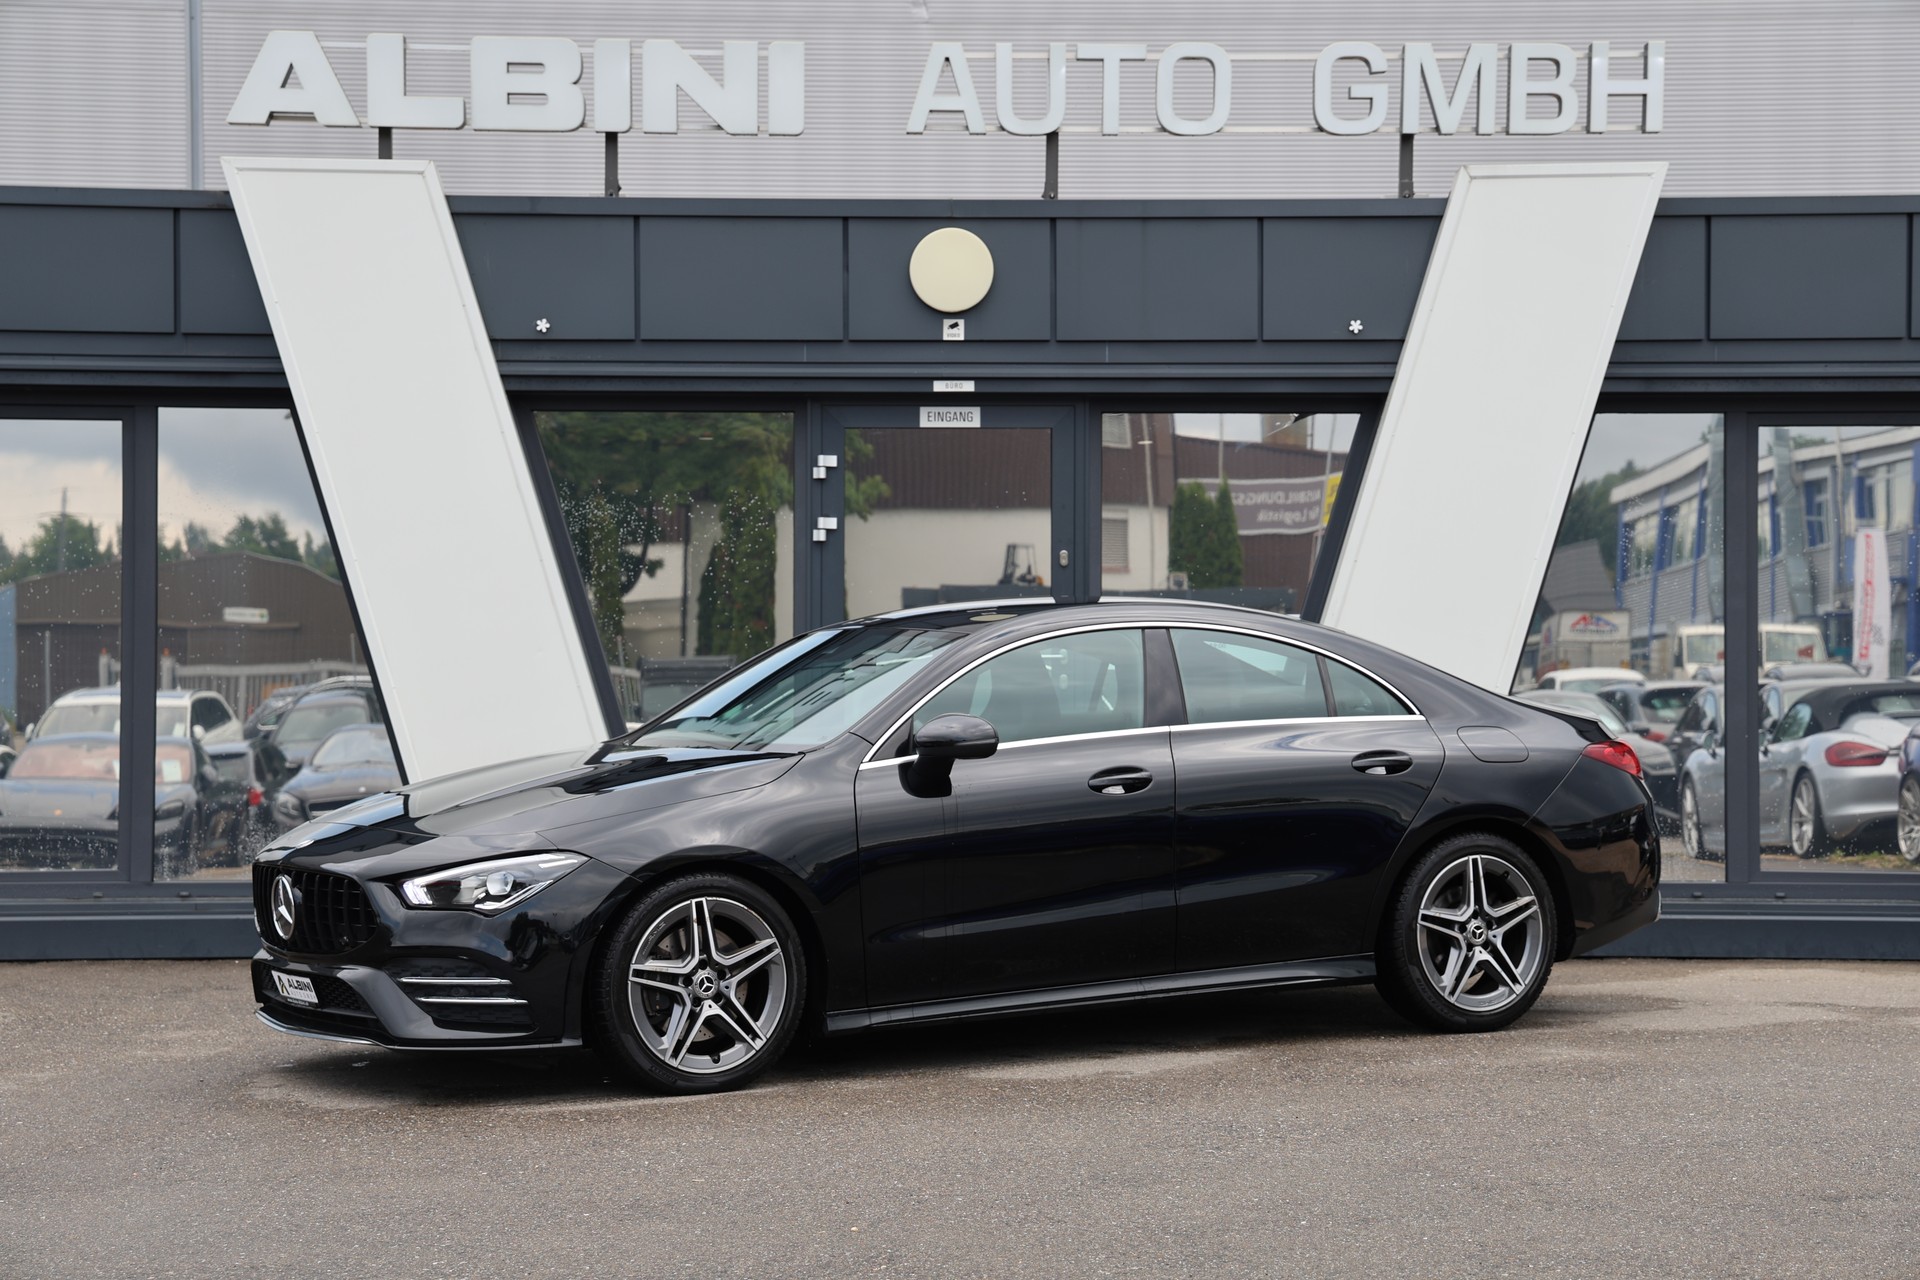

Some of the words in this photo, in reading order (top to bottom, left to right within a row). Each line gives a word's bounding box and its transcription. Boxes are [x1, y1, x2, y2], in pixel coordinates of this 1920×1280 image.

[227, 30, 805, 136] ALBINI
[906, 41, 1232, 136] AUTO
[1312, 40, 1666, 136] GMBH
[927, 411, 974, 422] EINGANG
[287, 977, 313, 993] ALBINI
